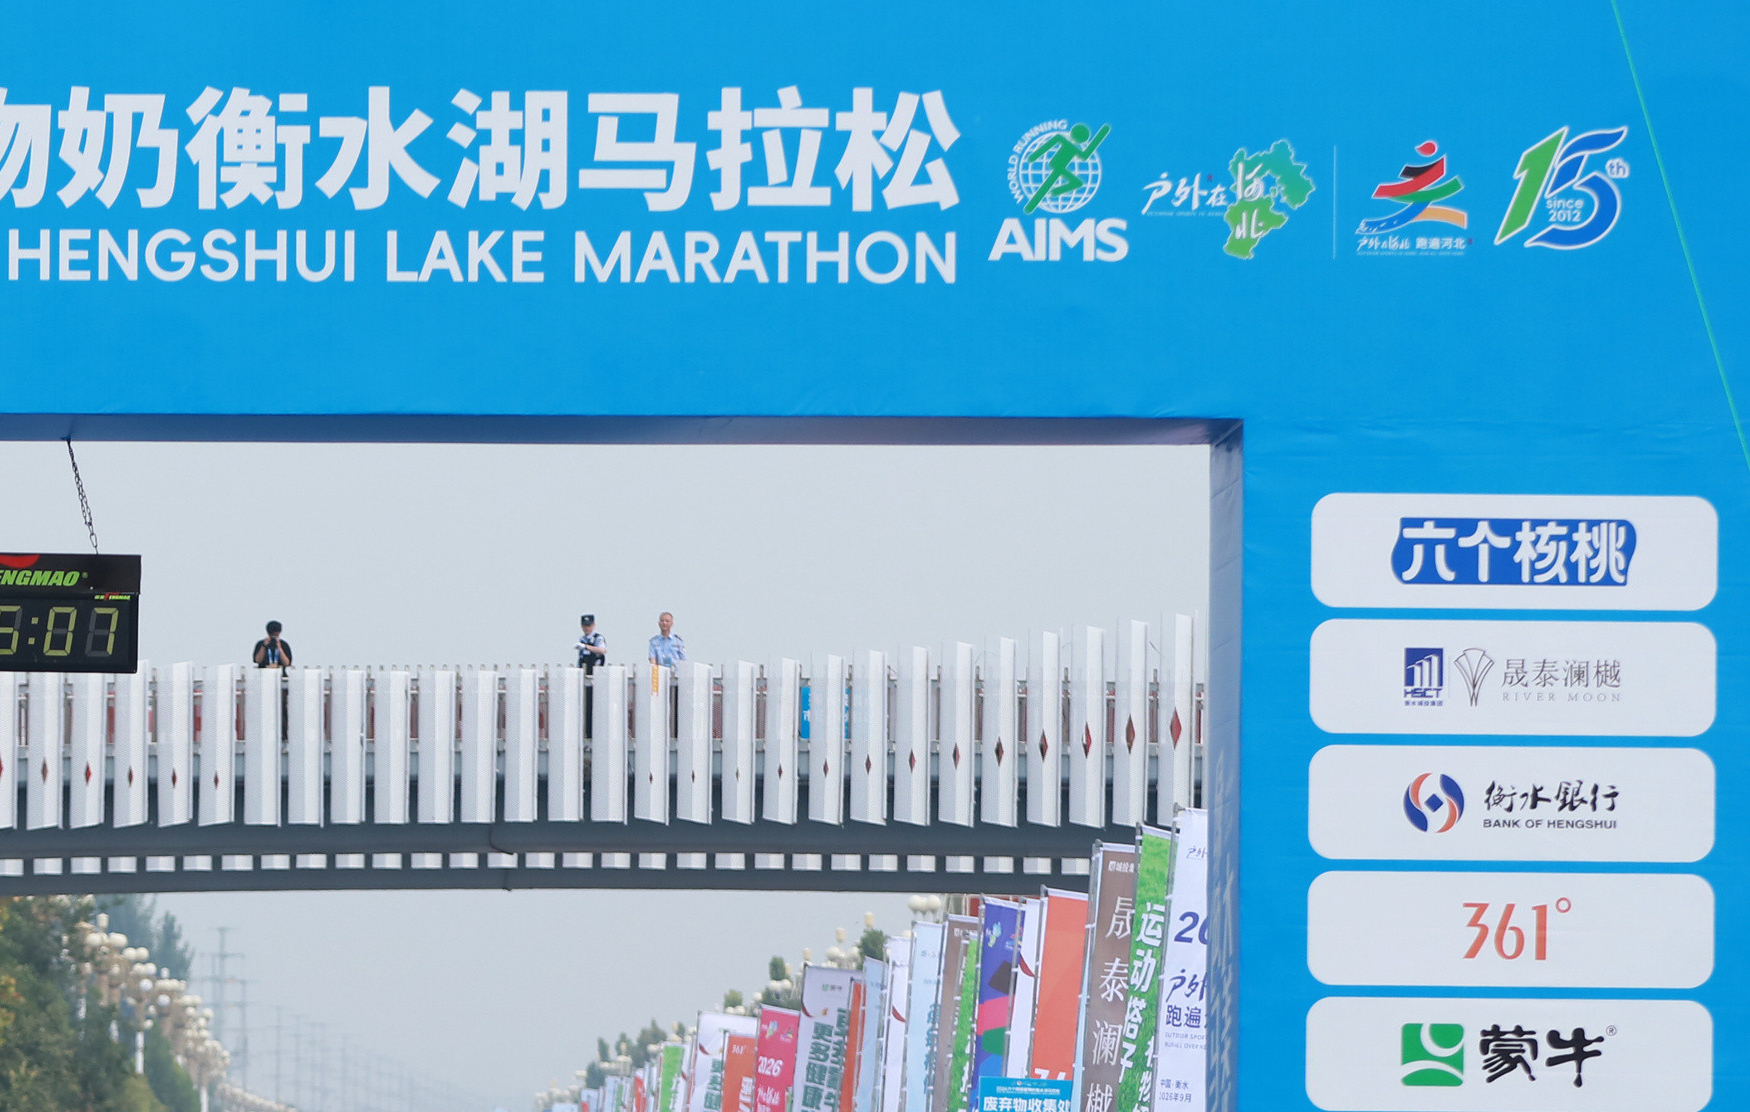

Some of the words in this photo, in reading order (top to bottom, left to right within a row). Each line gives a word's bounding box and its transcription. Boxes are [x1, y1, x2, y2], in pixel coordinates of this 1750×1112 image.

[1013, 119, 1068, 152] RUNNING
[1007, 152, 1025, 204] WORLD
[1606, 160, 1629, 178] th
[1495, 125, 1628, 250] 15
[1545, 197, 1585, 209] since
[1548, 210, 1581, 222] 2012
[988, 217, 1129, 262] AIMS
[8, 228, 356, 283] HENGSHUI
[386, 229, 545, 283] LAKE
[574, 230, 957, 285] MARATHON
[1401, 519, 1627, 585] 六个核桃
[1501, 658, 1621, 689] 晟泰澜樾
[1404, 688, 1443, 698] HSCT
[1502, 692, 1556, 703] RIVER
[1567, 692, 1621, 703] MOON
[1483, 819, 1521, 829] BANK
[1525, 819, 1543, 829] OF
[1547, 819, 1617, 829] HENGSHUI
[1462, 897, 1572, 962] 361°
[1118, 901, 1165, 1084] 运动搭子
[1165, 1004, 1207, 1028] 跑遍
[1190, 1033, 1207, 1041] SPORT
[1479, 1024, 1605, 1088] 蒙牛
